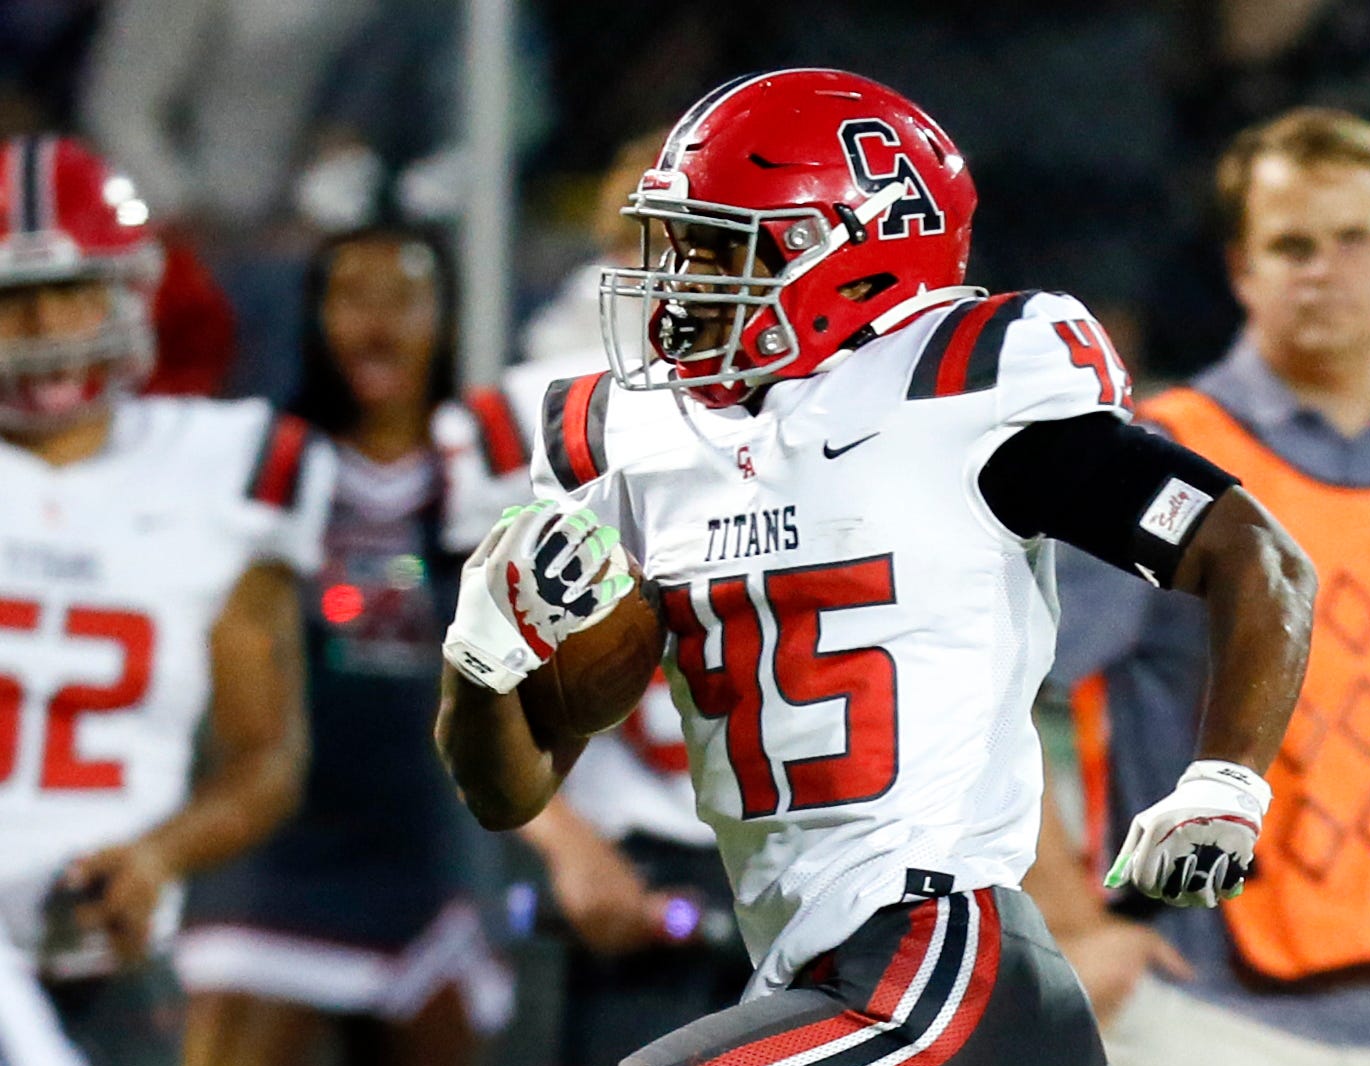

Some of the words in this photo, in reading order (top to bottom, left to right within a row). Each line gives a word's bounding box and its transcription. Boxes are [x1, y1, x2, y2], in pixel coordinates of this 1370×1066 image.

[837, 117, 946, 240] CA
[737, 445, 757, 479] CA
[704, 504, 799, 562] TITANS
[656, 551, 898, 820] 45
[922, 876, 936, 893] L
